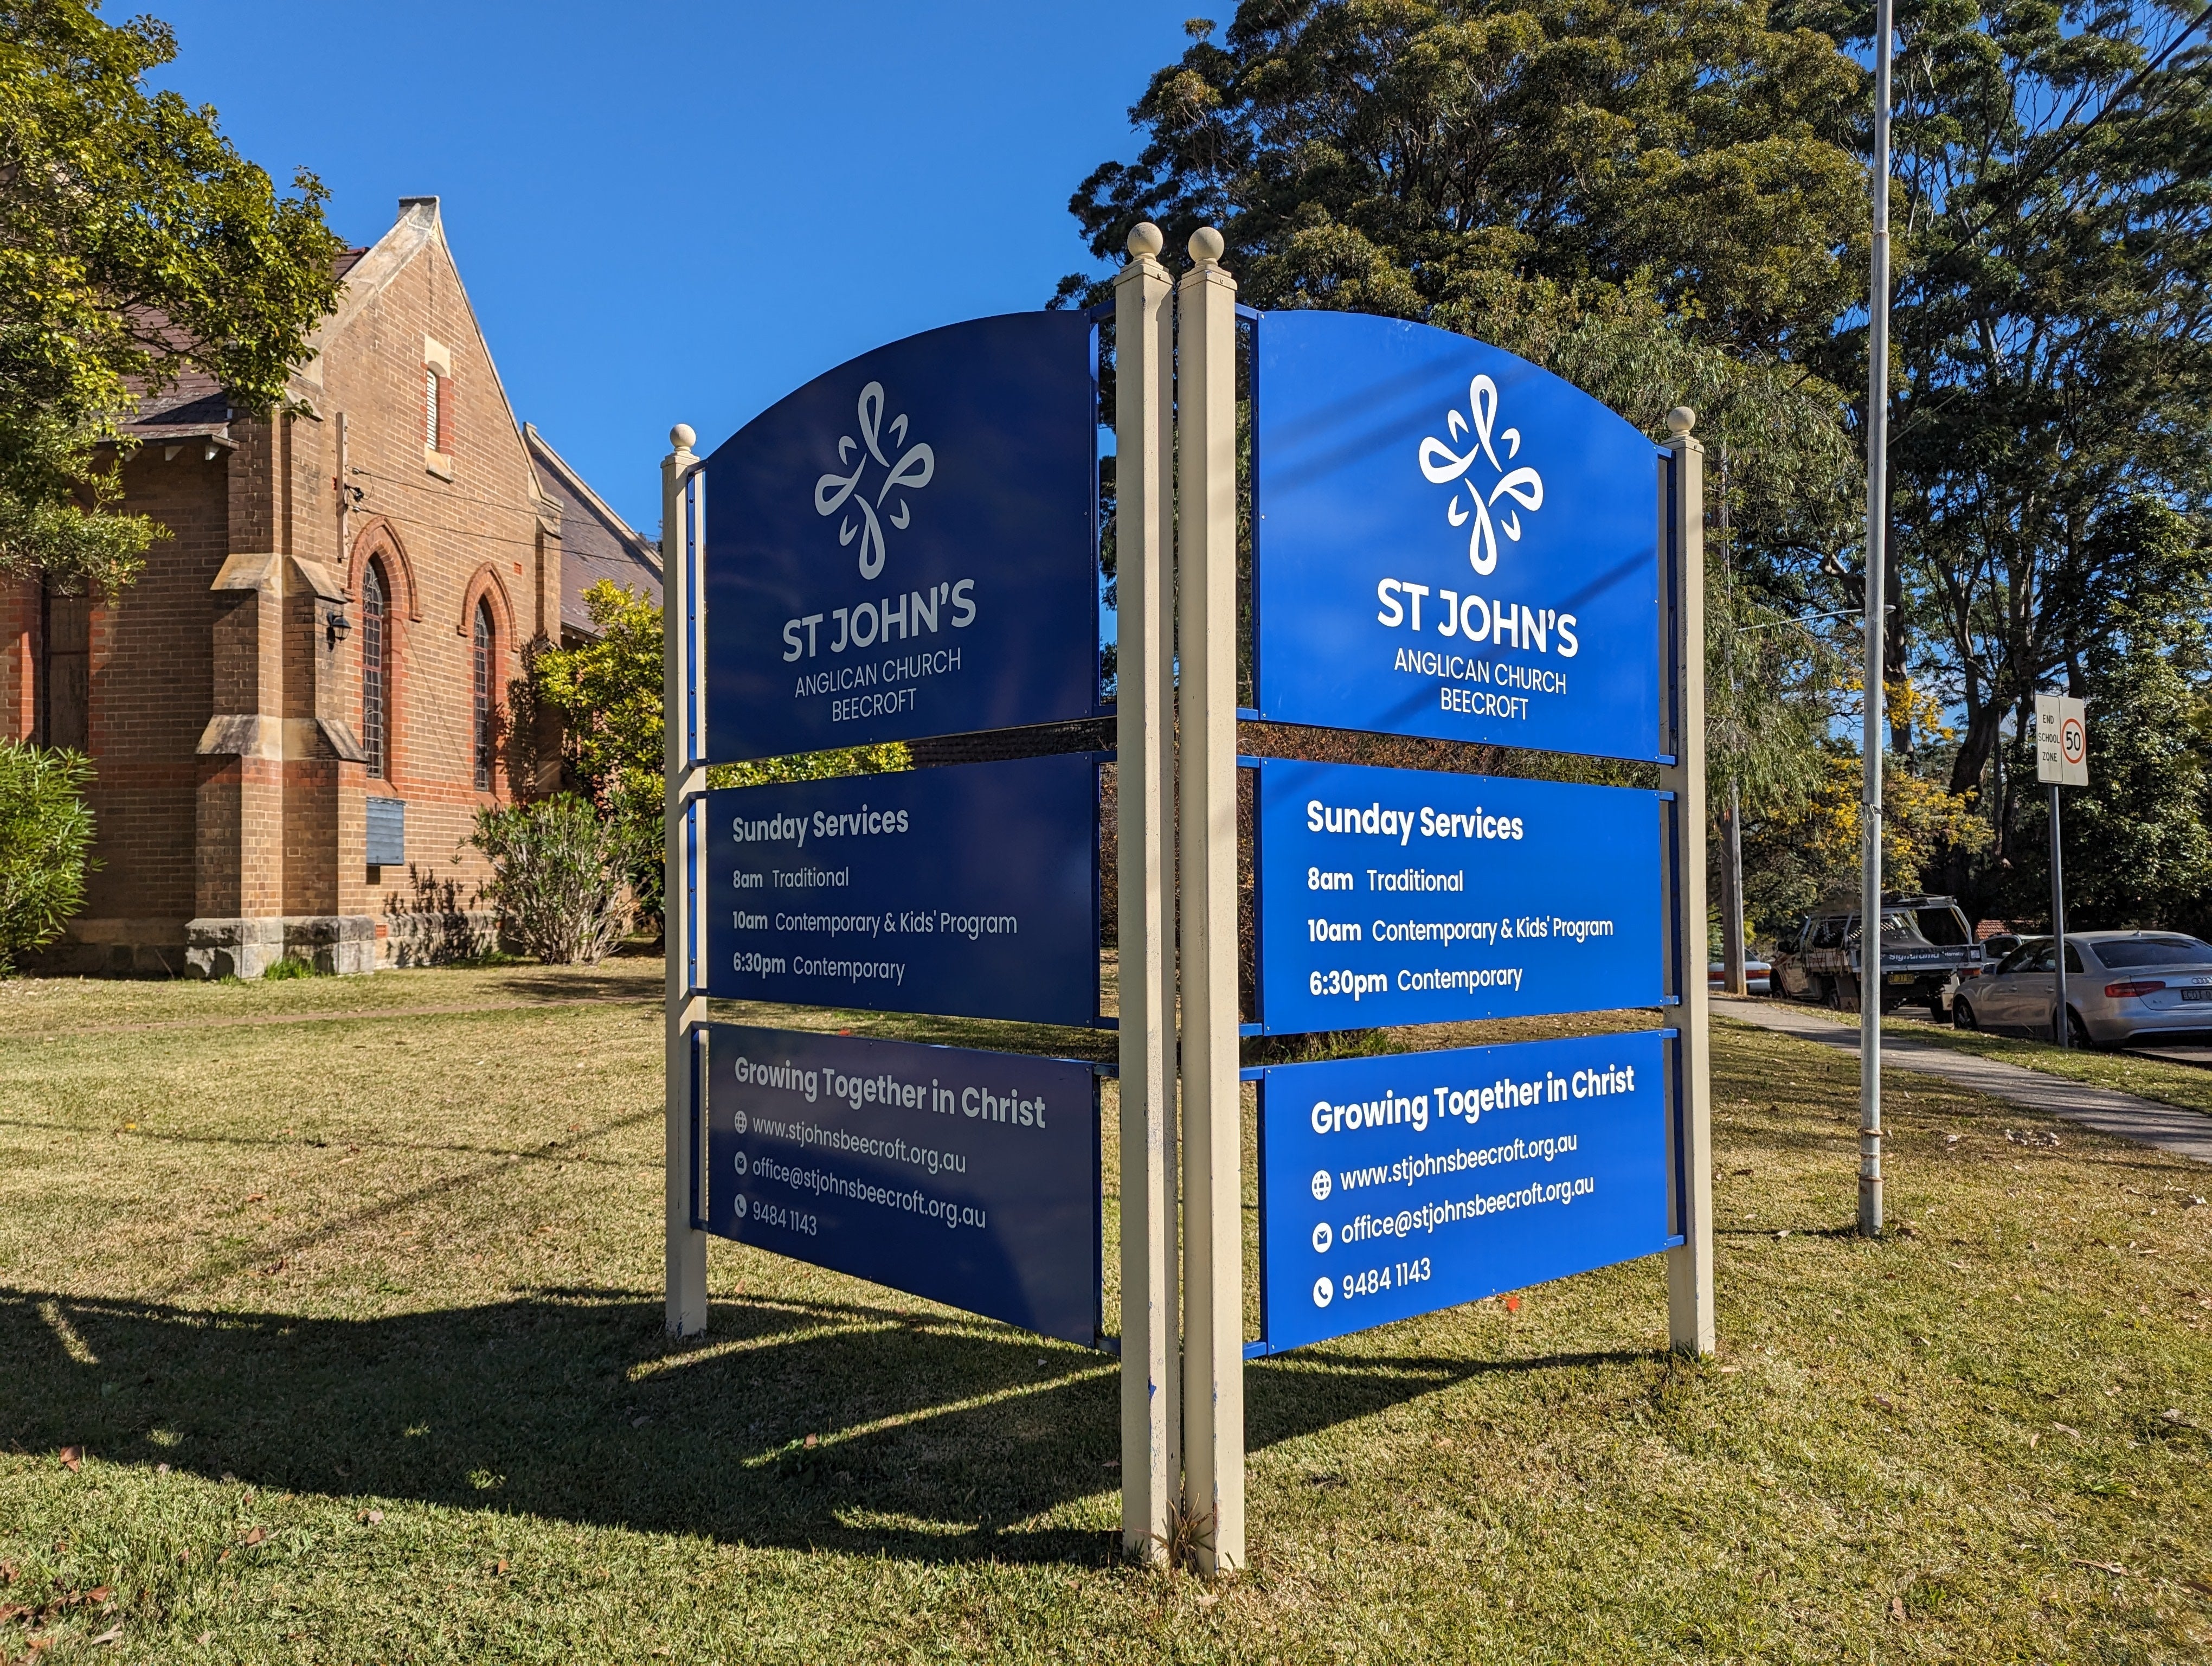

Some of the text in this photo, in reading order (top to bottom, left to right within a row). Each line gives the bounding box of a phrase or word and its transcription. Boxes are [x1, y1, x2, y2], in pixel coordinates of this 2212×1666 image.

[1377, 578, 1429, 631] ST
[783, 613, 824, 662] ST
[795, 647, 961, 698] ANGLICAN CHURCH
[1394, 648, 1566, 695] ANGLICAN CHURCH
[832, 688, 917, 722] BEECROFT
[1441, 687, 1529, 720] BEECROFT
[2043, 714, 2054, 724] END
[2038, 732, 2060, 744] SCHOOL
[2042, 752, 2057, 762] ZONE
[2066, 731, 2081, 751] 50
[732, 804, 909, 848] Sunday Services
[1307, 800, 1523, 846] Sunday Services
[733, 866, 848, 888] 8am Traditional
[1308, 867, 1463, 892] 8am Traditional
[732, 909, 1017, 940] 10am Contemporary & Kids' Program
[1308, 915, 1613, 947] 10am Contemporary & Kids' Program
[733, 952, 905, 986] 6:30pm Contemporary
[1310, 968, 1523, 1001] 6:30pm Contemporary
[735, 1056, 1045, 1129] Growing Together in Christ
[1311, 1063, 1635, 1134] Growing Together in Christ
[752, 1117, 966, 1175] www.stjohnsbeecroft.org.au
[1340, 1135, 1577, 1190] www.stjohnsbeecroft.org.au
[753, 1157, 986, 1229] office@stjohnsbeecroft.org.au
[1341, 1177, 1594, 1244] office@stjohnsbeecroft.org.au
[753, 1201, 817, 1236] 9484 1143
[1343, 1257, 1431, 1299] 9484 1143
